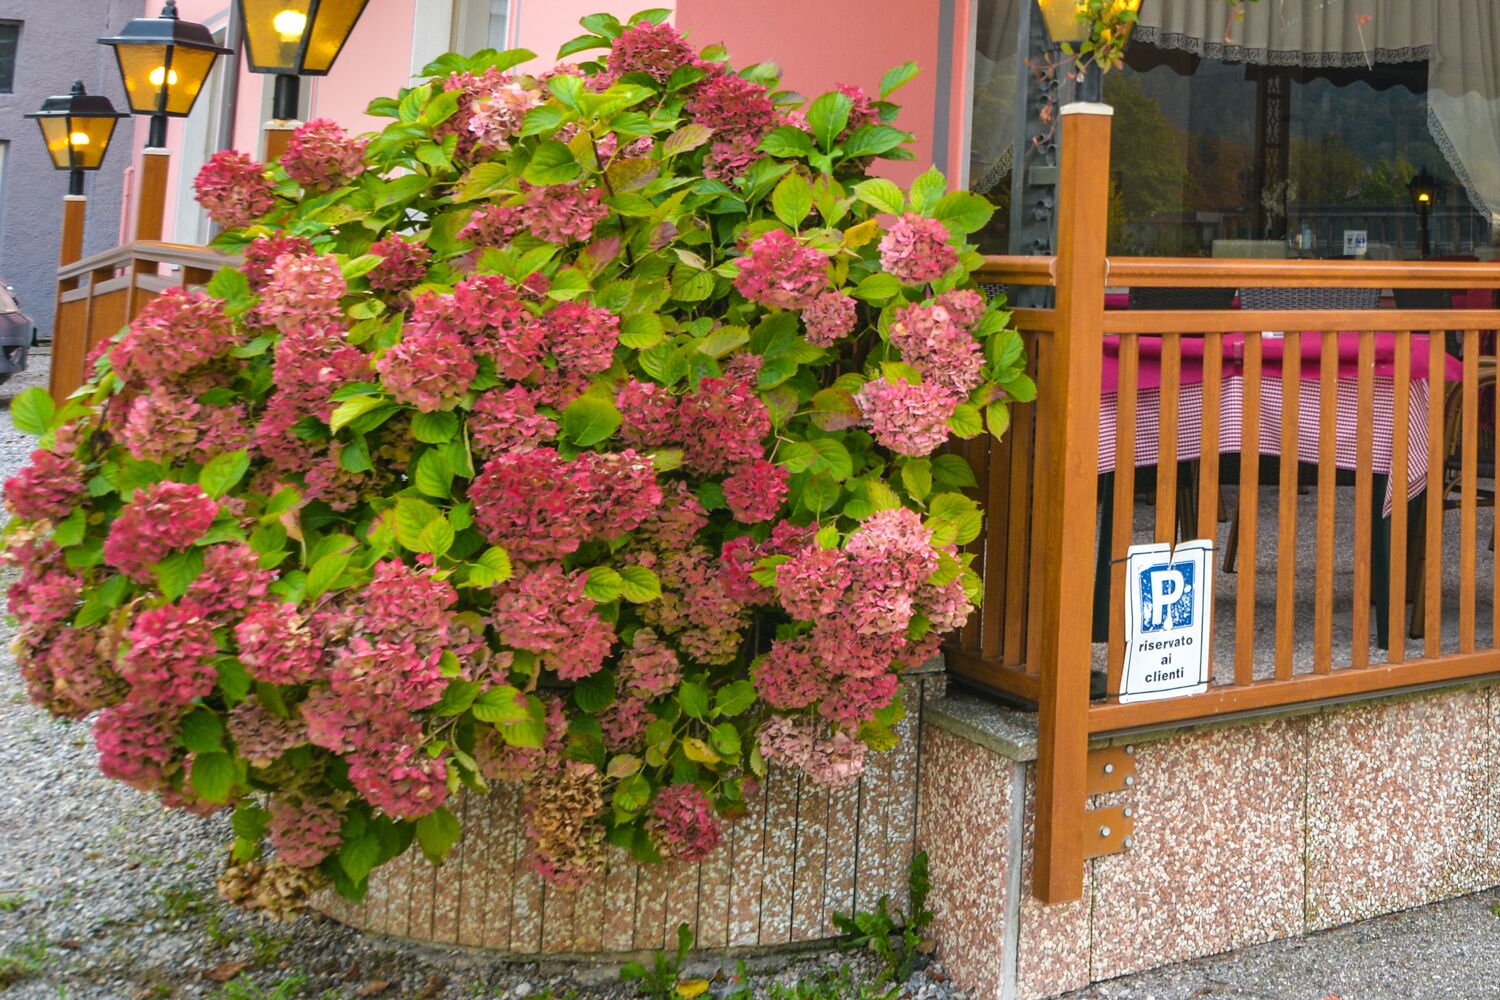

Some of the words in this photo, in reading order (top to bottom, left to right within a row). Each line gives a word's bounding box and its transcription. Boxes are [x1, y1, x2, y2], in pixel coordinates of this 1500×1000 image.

[1150, 569, 1185, 625] P
[1138, 635, 1193, 652] riservato
[1160, 653, 1172, 665] ai
[1145, 666, 1184, 683] clienti
